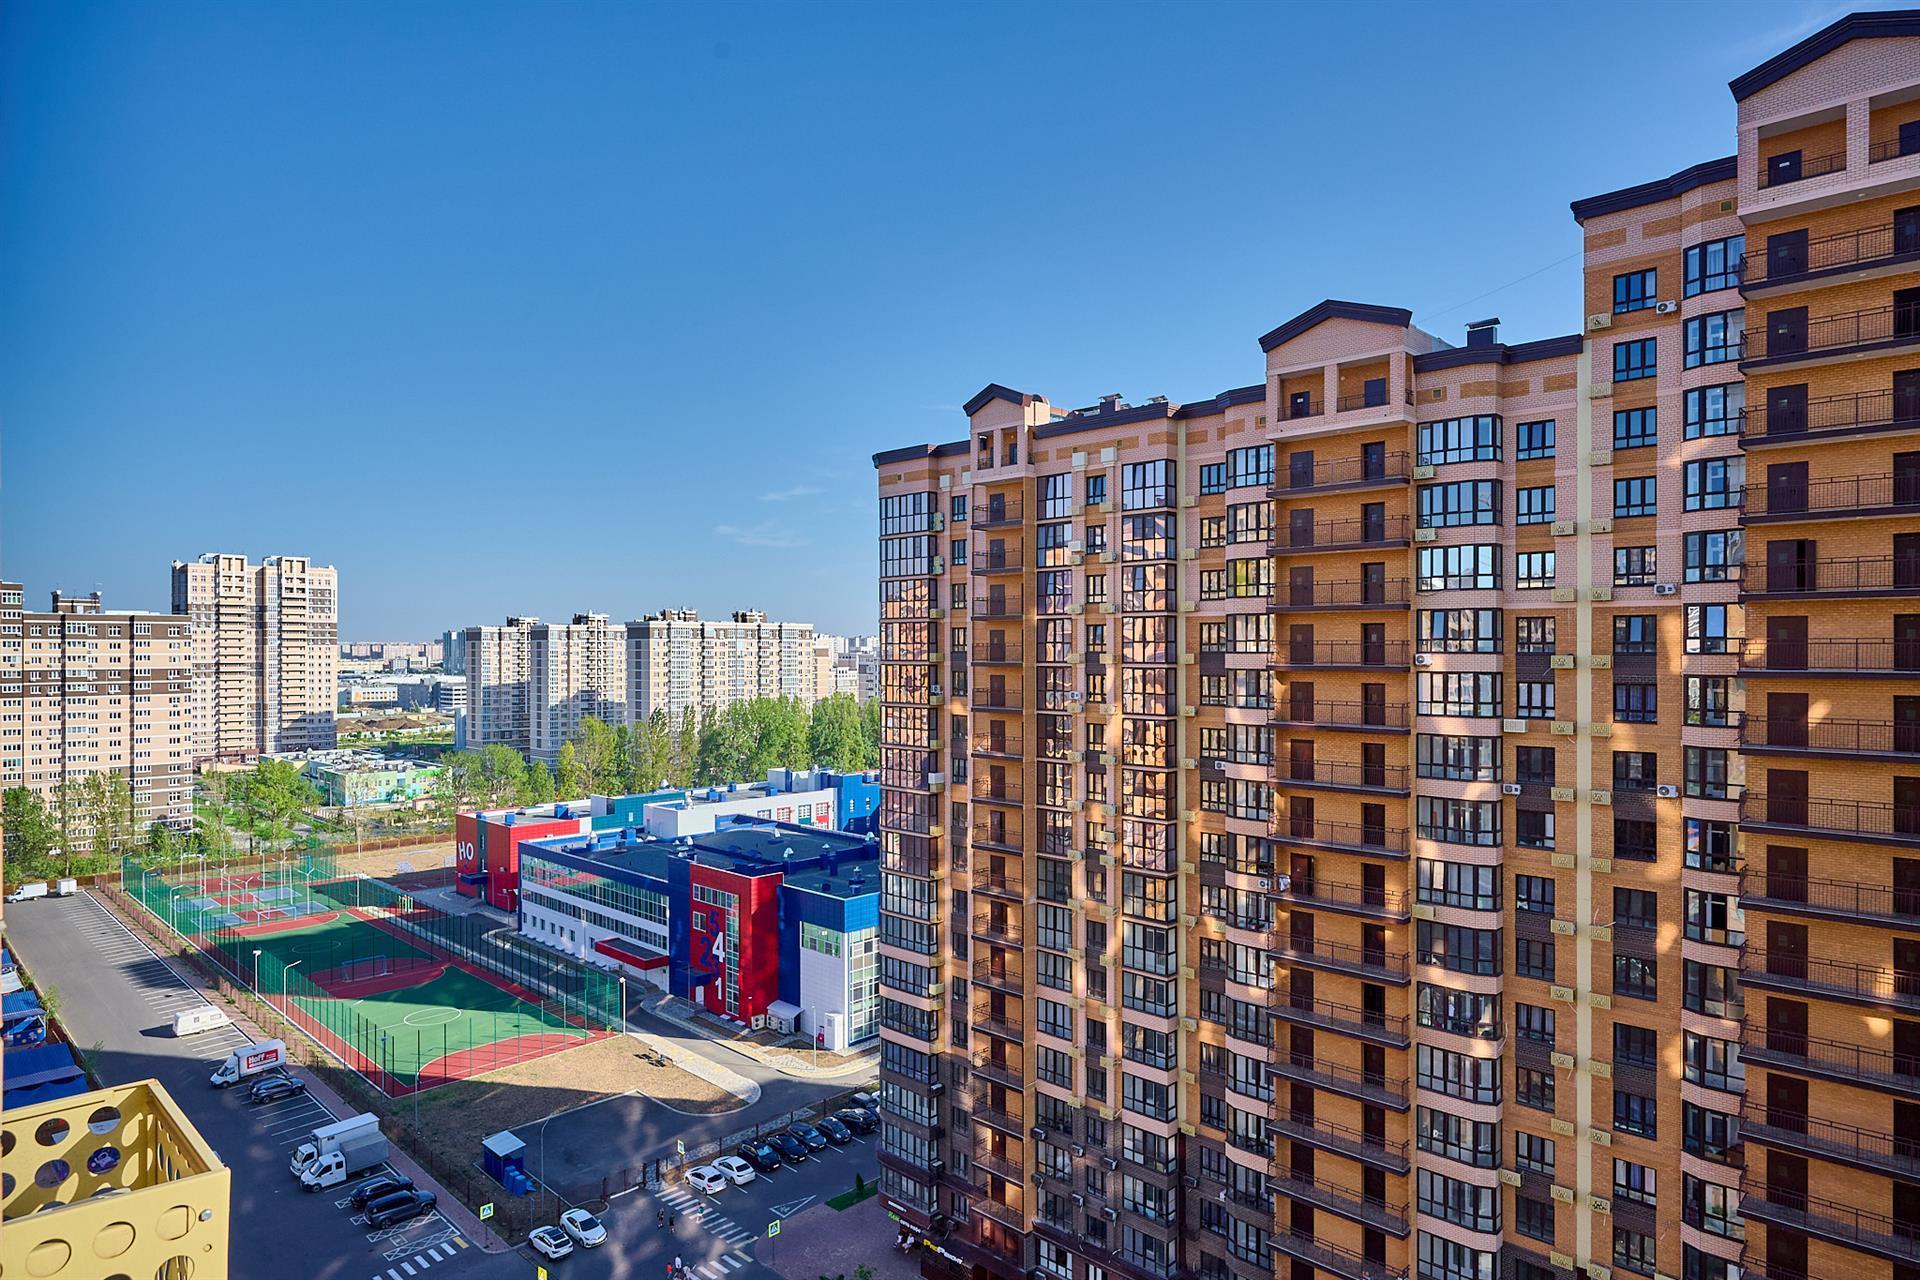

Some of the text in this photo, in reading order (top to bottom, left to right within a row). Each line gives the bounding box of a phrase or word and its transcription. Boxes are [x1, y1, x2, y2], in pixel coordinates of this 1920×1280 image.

[709, 911, 719, 936] 5
[700, 936, 711, 967] 2
[712, 931, 725, 963] 4
[715, 977, 722, 1000] 1
